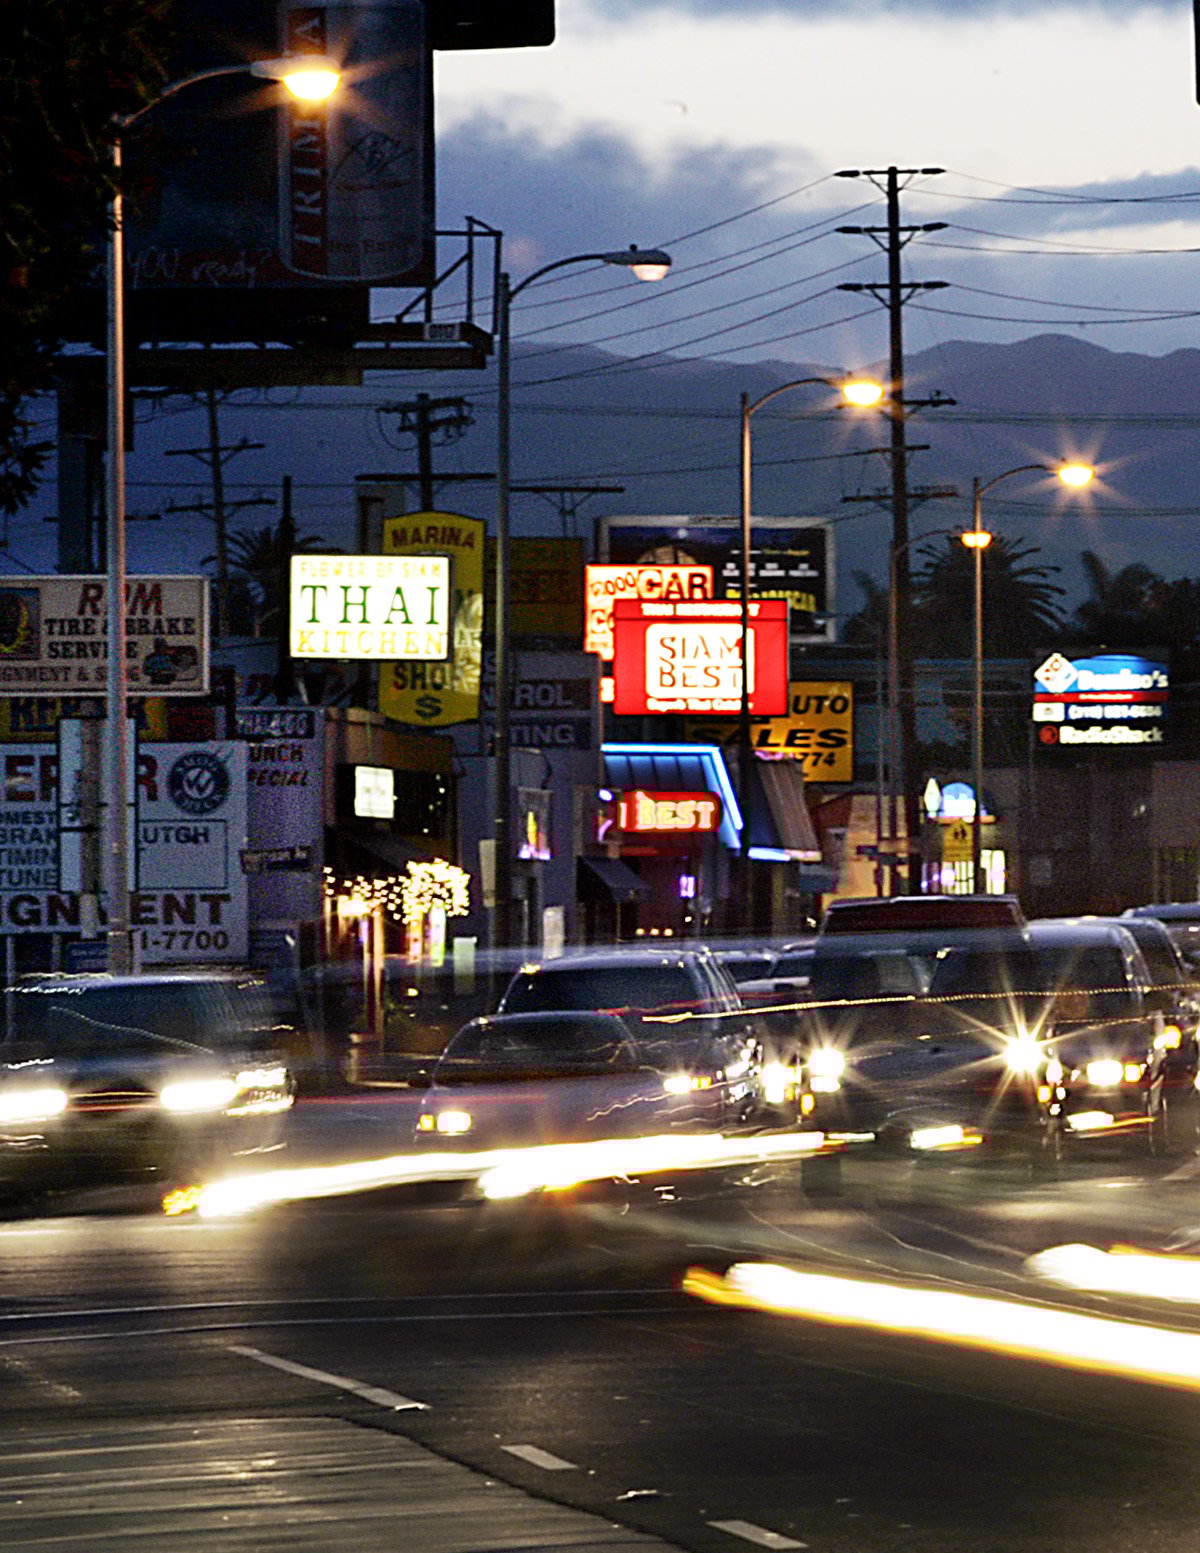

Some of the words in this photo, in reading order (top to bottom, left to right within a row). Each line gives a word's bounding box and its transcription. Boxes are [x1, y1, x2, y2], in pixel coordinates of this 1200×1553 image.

[293, 16, 323, 248] TRIMA
[391, 526, 475, 549] MARINA
[635, 567, 708, 601] CAR
[77, 582, 164, 617] RM
[301, 584, 442, 626] THAI
[44, 617, 97, 637] TIRE
[48, 640, 139, 660] SERVIE
[296, 629, 448, 655] KITCHEN
[659, 657, 742, 689] BEST
[791, 694, 849, 716] UTO
[251, 745, 303, 762] UNCH
[248, 769, 308, 786] PECIAL
[636, 792, 715, 829] BEST
[0, 893, 231, 926] GNENT
